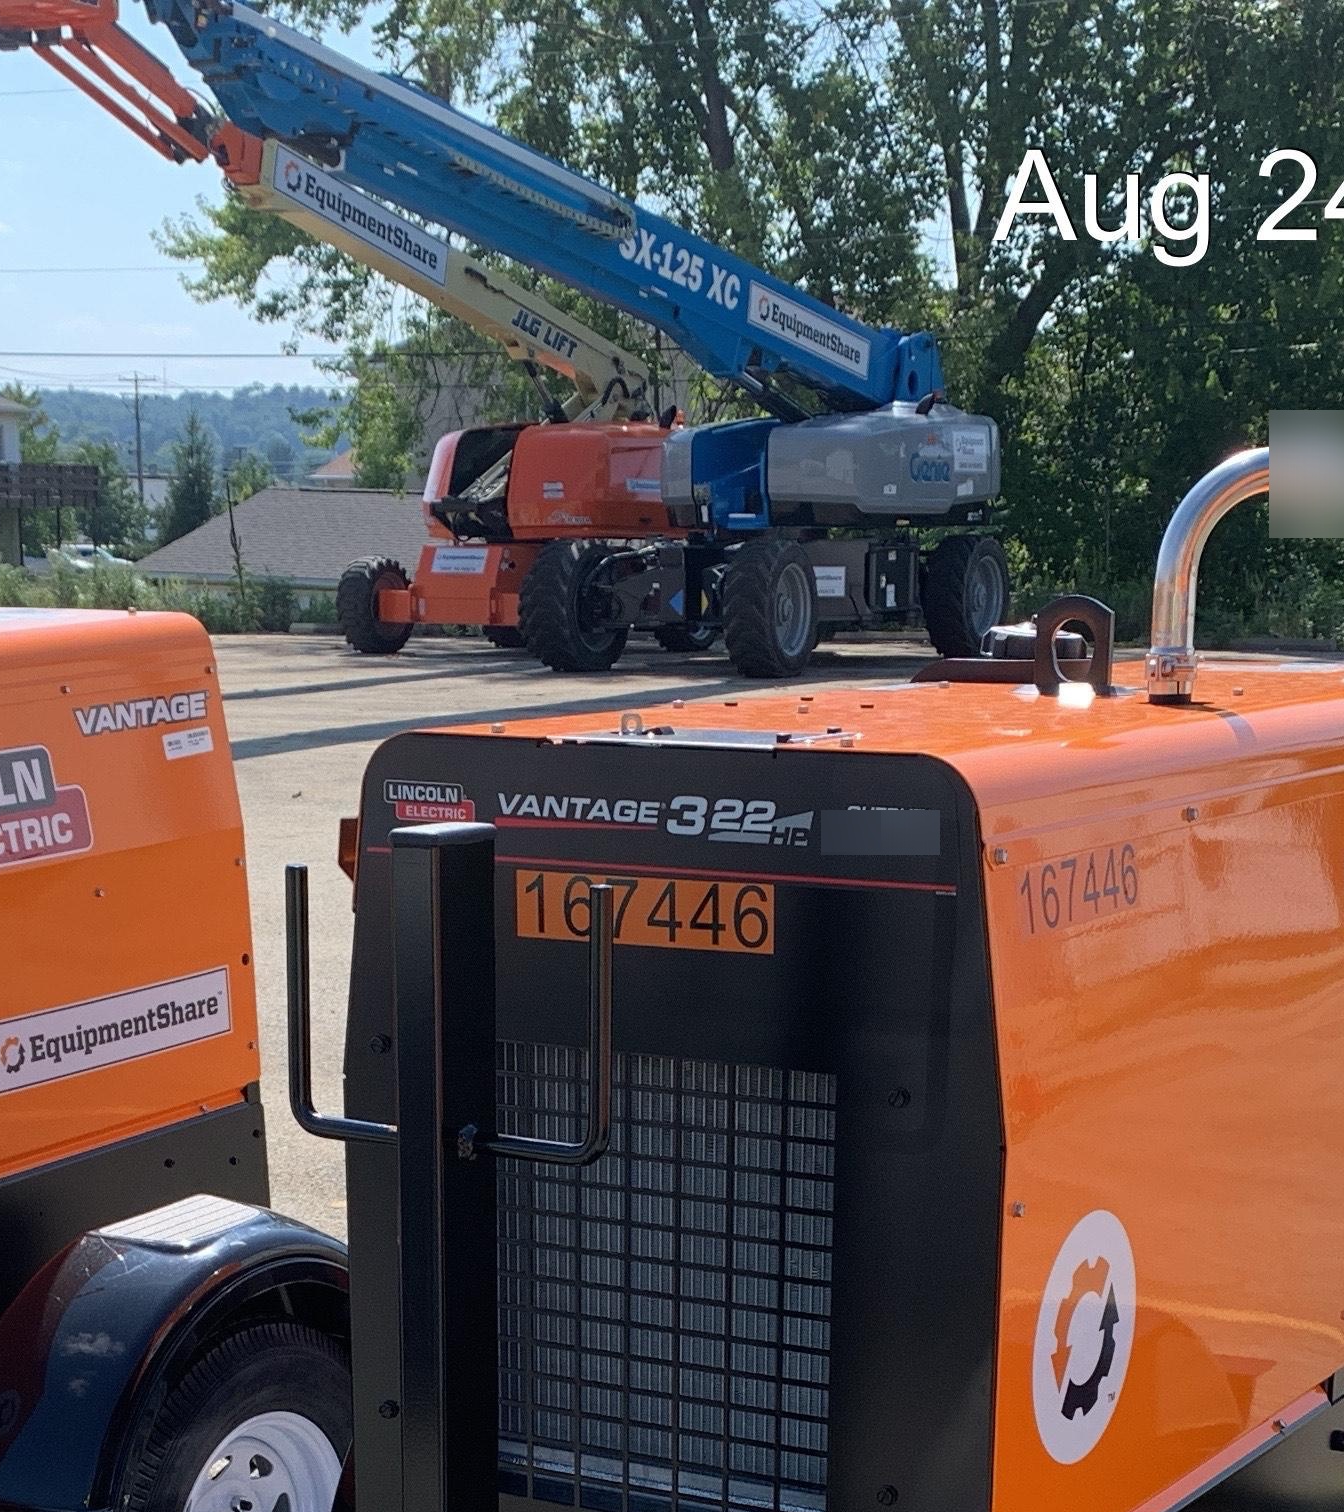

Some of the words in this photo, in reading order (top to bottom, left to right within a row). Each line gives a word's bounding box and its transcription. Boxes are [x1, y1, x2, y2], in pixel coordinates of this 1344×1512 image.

[305, 172, 438, 269] EquipmentShare
[619, 227, 705, 293] SX-125
[706, 264, 742, 311] XC
[511, 309, 541, 338] JLG
[542, 325, 578, 358] LIFT
[772, 304, 861, 364] EquipmentShare
[73, 691, 208, 737] VANTAGE
[388, 783, 458, 803] LINCOLN
[406, 804, 467, 820] ELECTRIC
[498, 792, 661, 824] VANTAGE
[525, 873, 769, 949] 167446
[1021, 843, 1138, 934] 167446
[29, 995, 219, 1064] EquipmentShare
